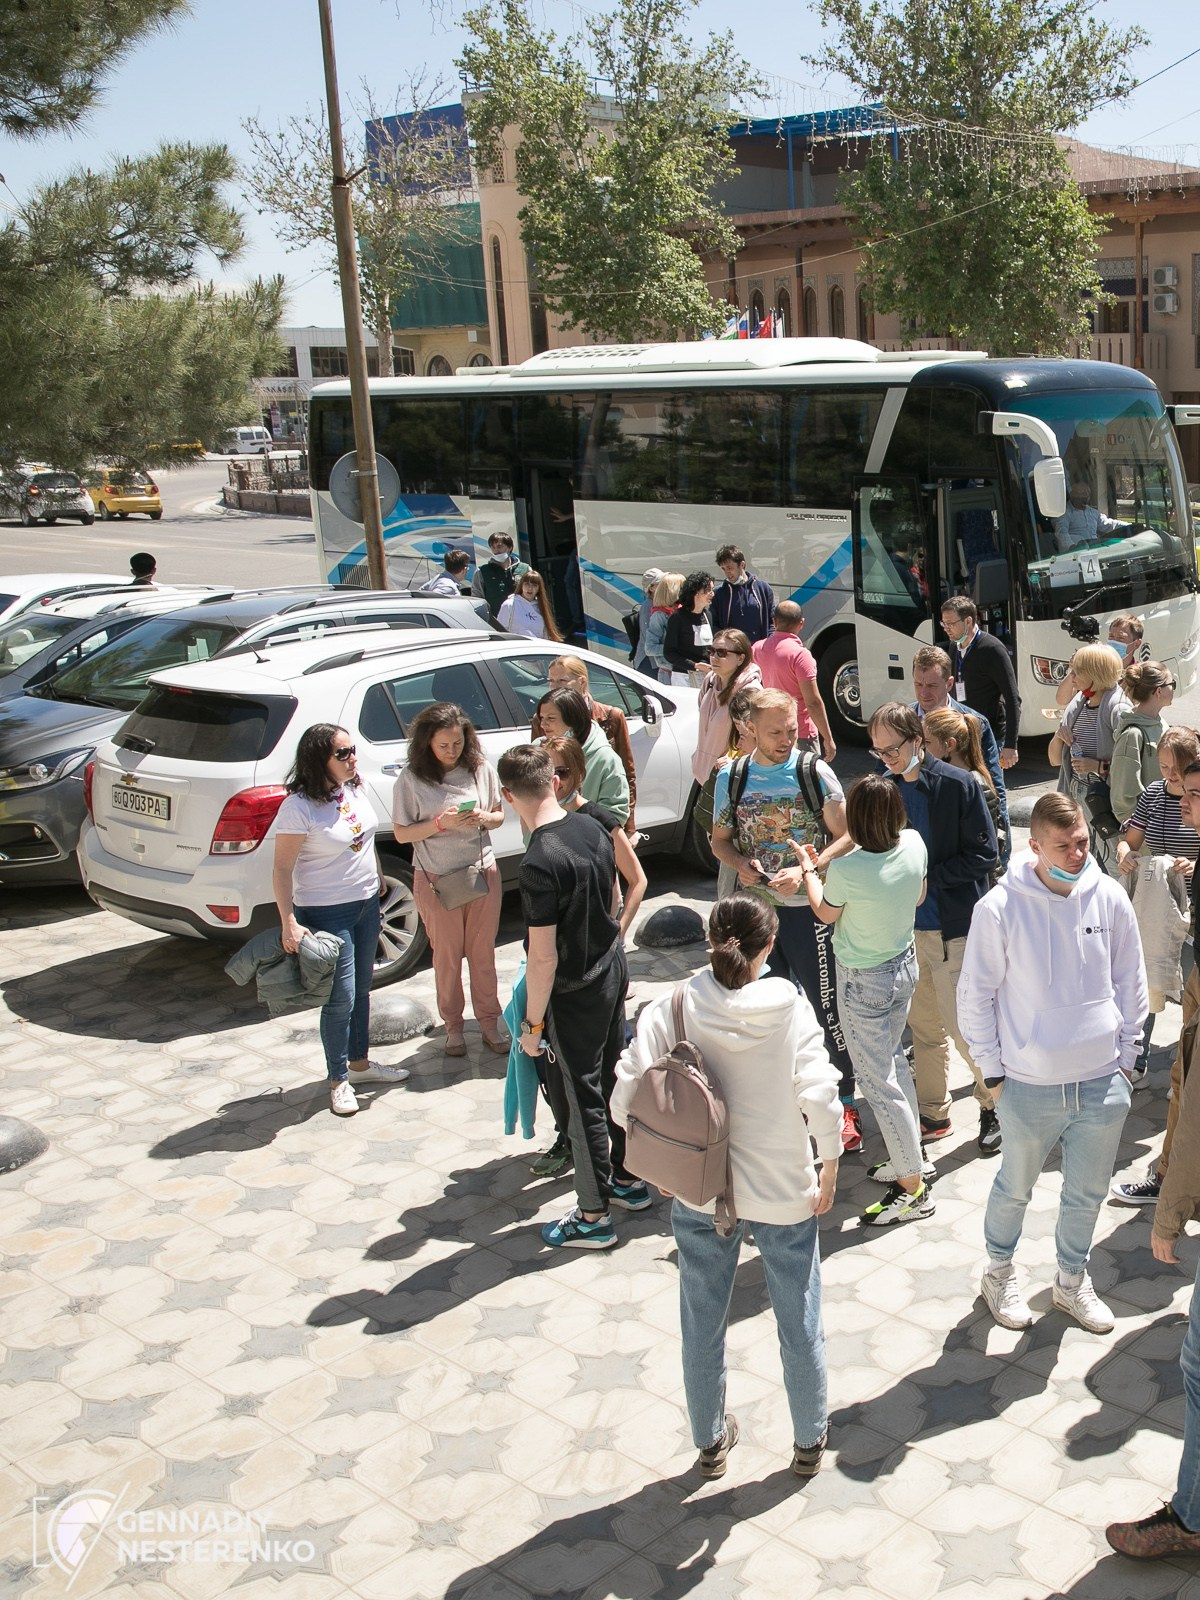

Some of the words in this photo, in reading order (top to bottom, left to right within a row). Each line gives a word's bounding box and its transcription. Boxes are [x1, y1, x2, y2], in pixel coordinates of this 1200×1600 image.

[1087, 559, 1096, 576] 4
[813, 922, 834, 1009] Abercrombie
[826, 1012, 834, 1024] &
